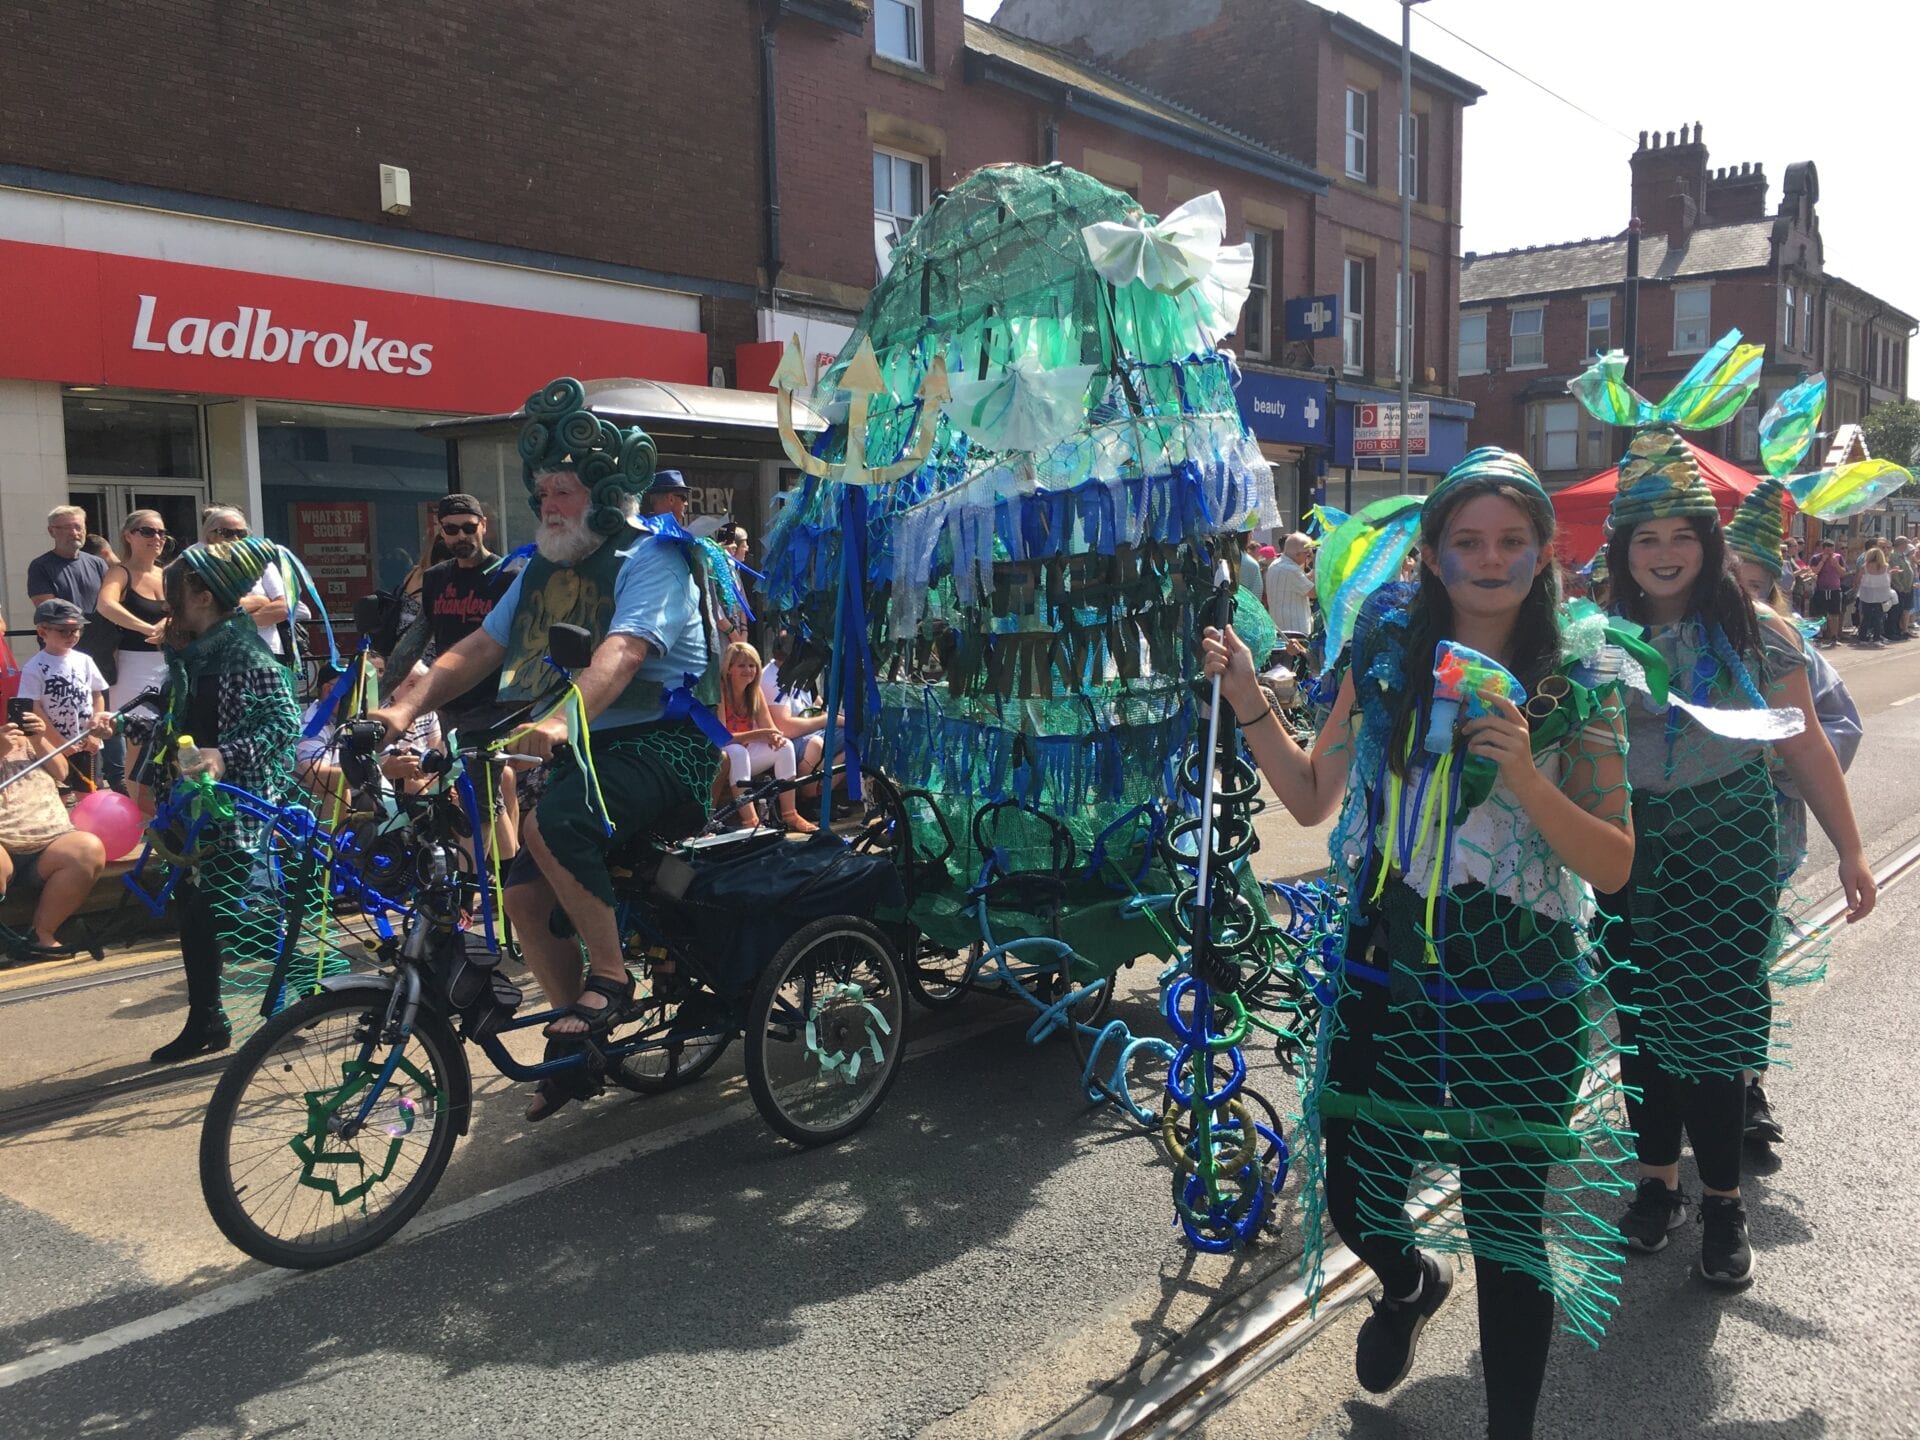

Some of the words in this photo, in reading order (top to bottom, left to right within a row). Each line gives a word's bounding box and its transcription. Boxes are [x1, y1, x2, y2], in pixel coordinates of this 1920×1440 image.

[132, 294, 434, 376] Ladbrokes
[1254, 396, 1286, 419] beauty
[1383, 412, 1424, 420] Avaable
[1356, 440, 1377, 450] 0161
[1380, 440, 1397, 449] 631
[301, 510, 341, 524] WHAT'S
[343, 510, 363, 524] THE
[312, 524, 353, 538] SCORE?
[44, 679, 89, 705] BATMAN
